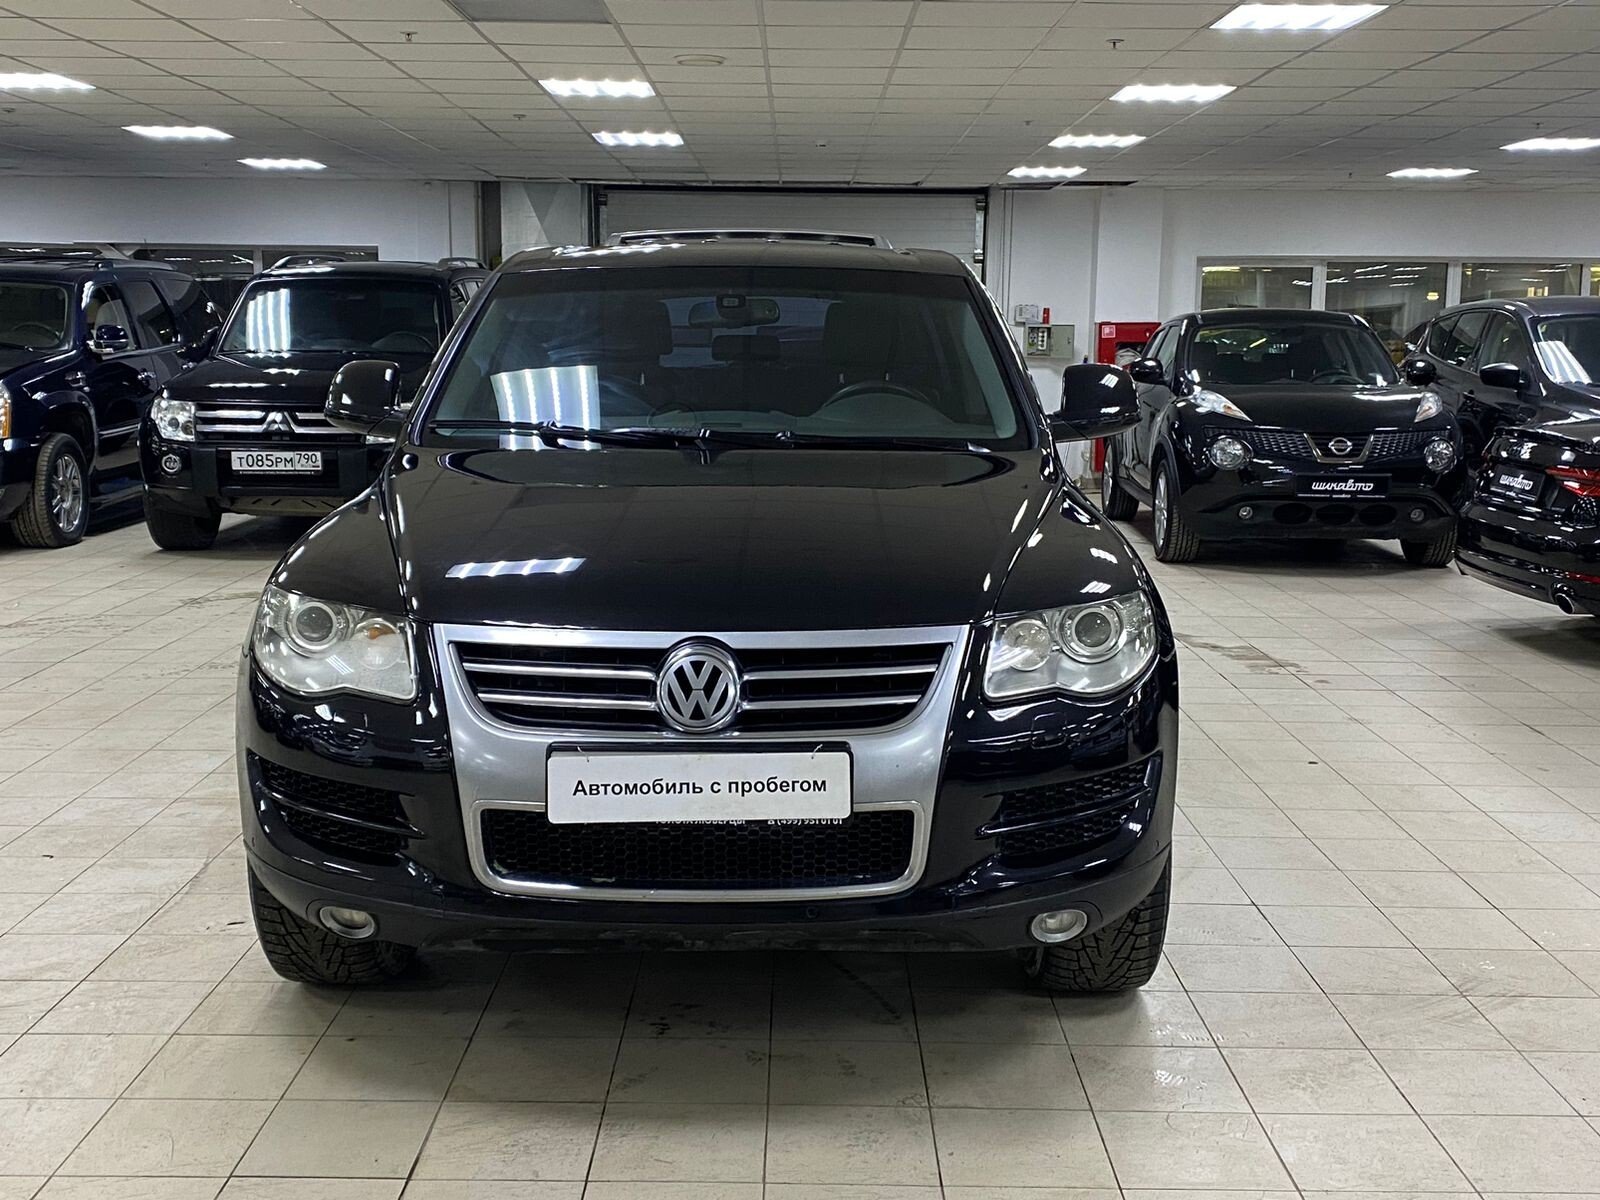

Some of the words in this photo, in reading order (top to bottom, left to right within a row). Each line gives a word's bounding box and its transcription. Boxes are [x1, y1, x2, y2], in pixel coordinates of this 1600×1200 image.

[295, 453, 318, 464] 790
[572, 778, 704, 796] Автомобиль
[710, 781, 721, 794] с
[728, 776, 827, 797] пробегом
